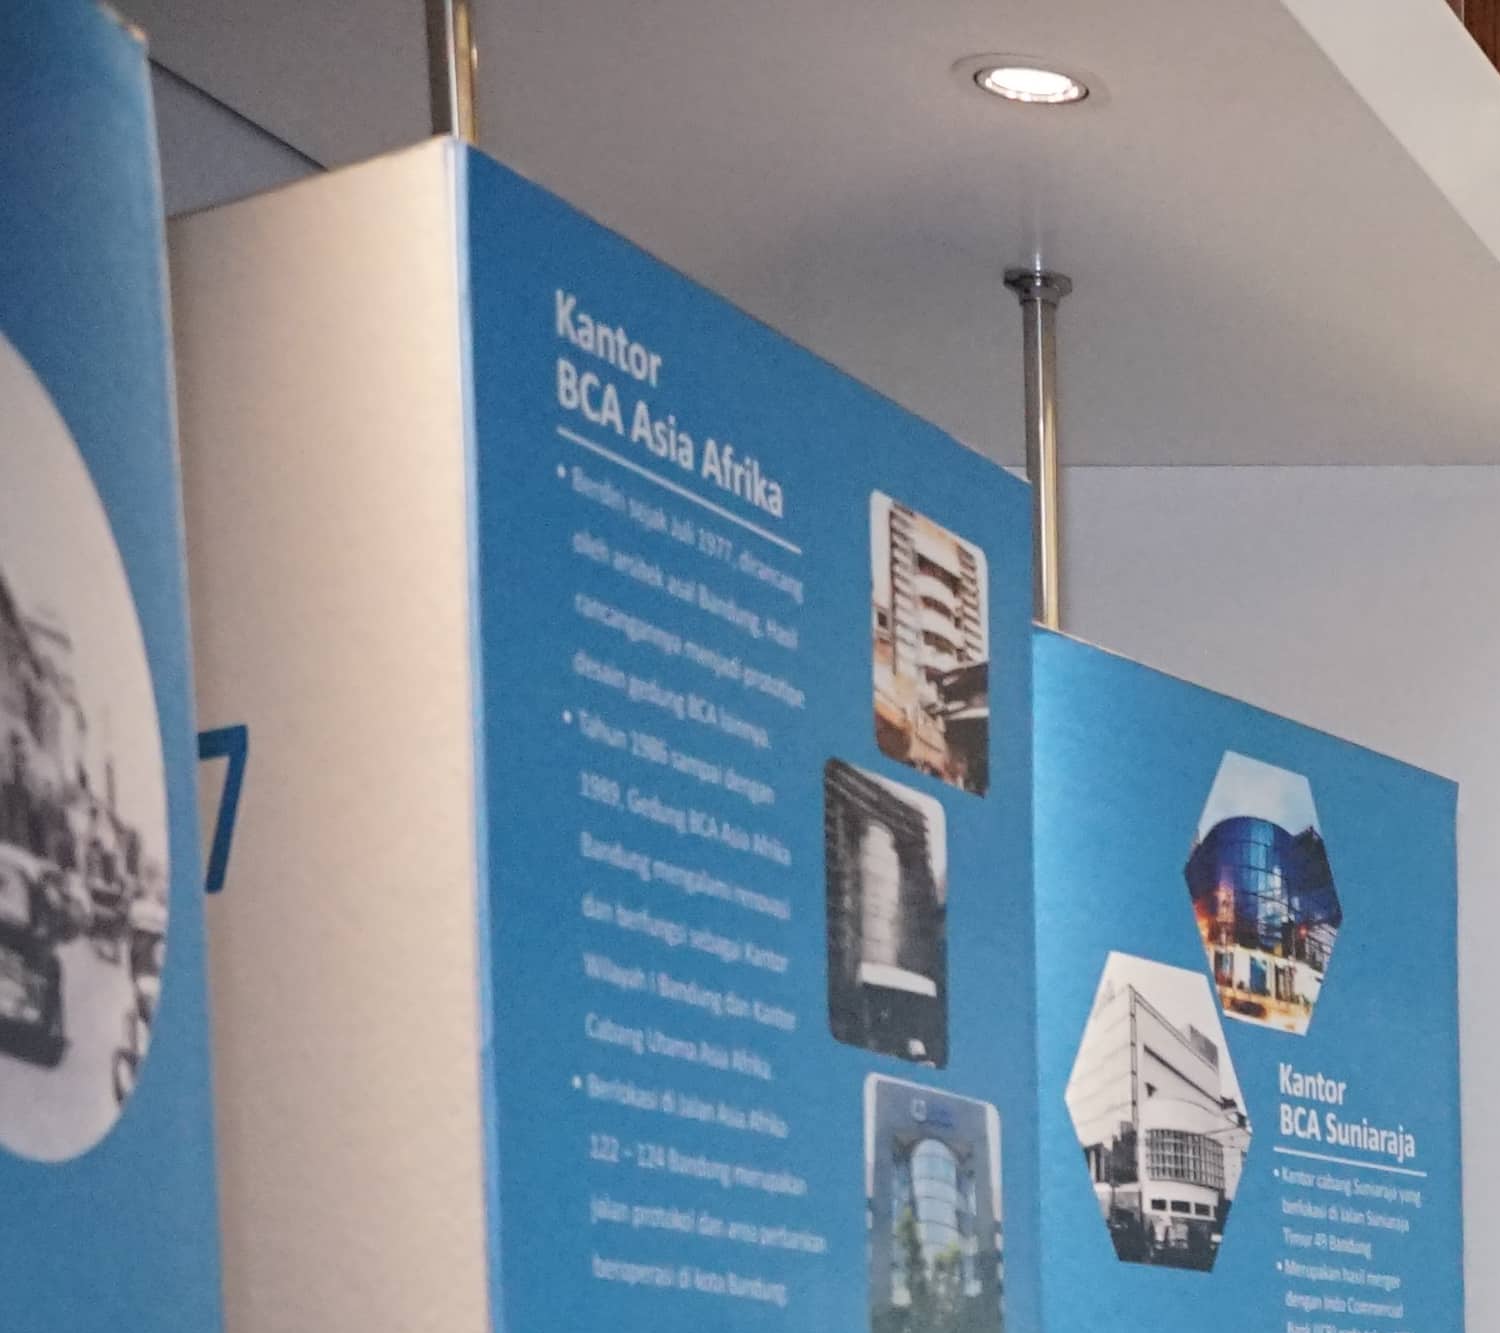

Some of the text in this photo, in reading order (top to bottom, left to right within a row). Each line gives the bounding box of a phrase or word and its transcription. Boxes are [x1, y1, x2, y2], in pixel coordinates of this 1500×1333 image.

[556, 288, 663, 388] Kantor
[557, 357, 784, 519] BCA Asia Afrika
[687, 693, 717, 725] BCA
[688, 808, 718, 838] BCA
[1278, 1062, 1346, 1105] Kantor
[1280, 1103, 1415, 1163] BCA Suniaraja
